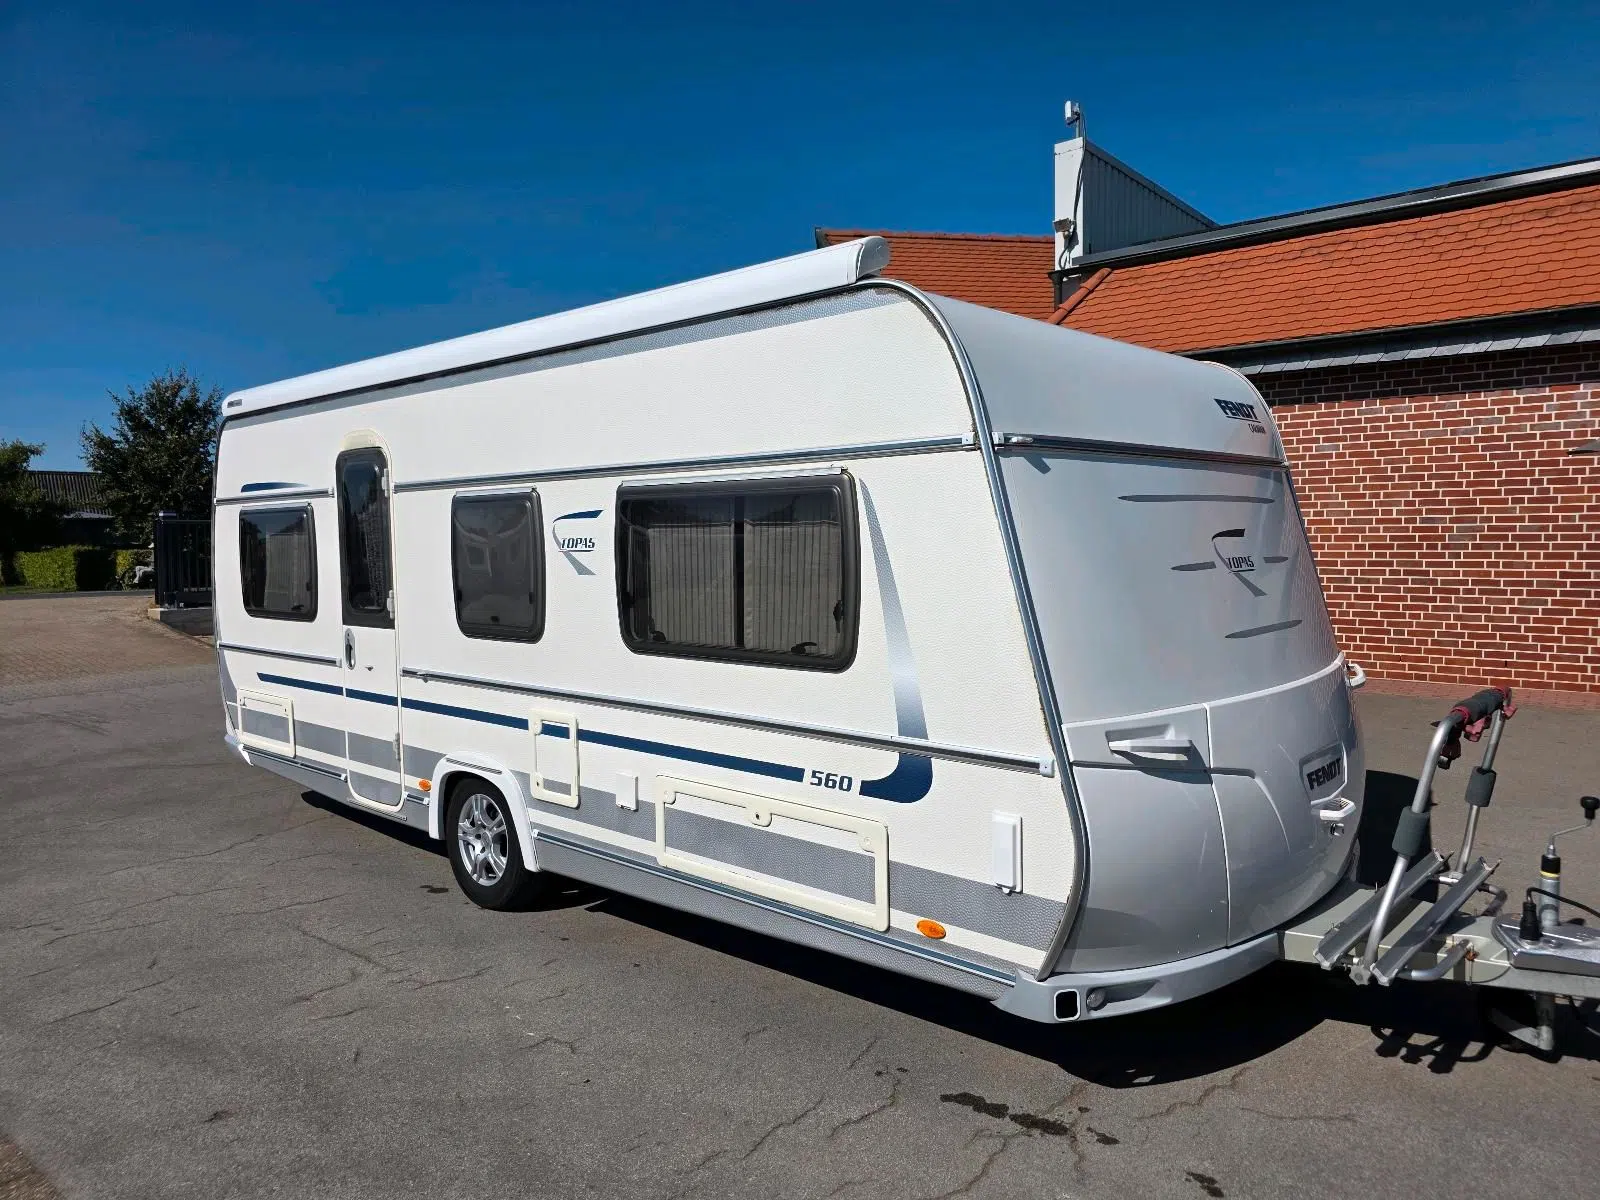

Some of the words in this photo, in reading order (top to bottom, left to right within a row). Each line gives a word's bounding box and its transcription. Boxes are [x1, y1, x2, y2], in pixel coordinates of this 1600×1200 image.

[1213, 398, 1259, 420] FENDT
[560, 536, 596, 549] TOPAS
[1225, 555, 1255, 569] TOPAS
[809, 769, 853, 792] 560
[1306, 756, 1342, 791] FENDT
